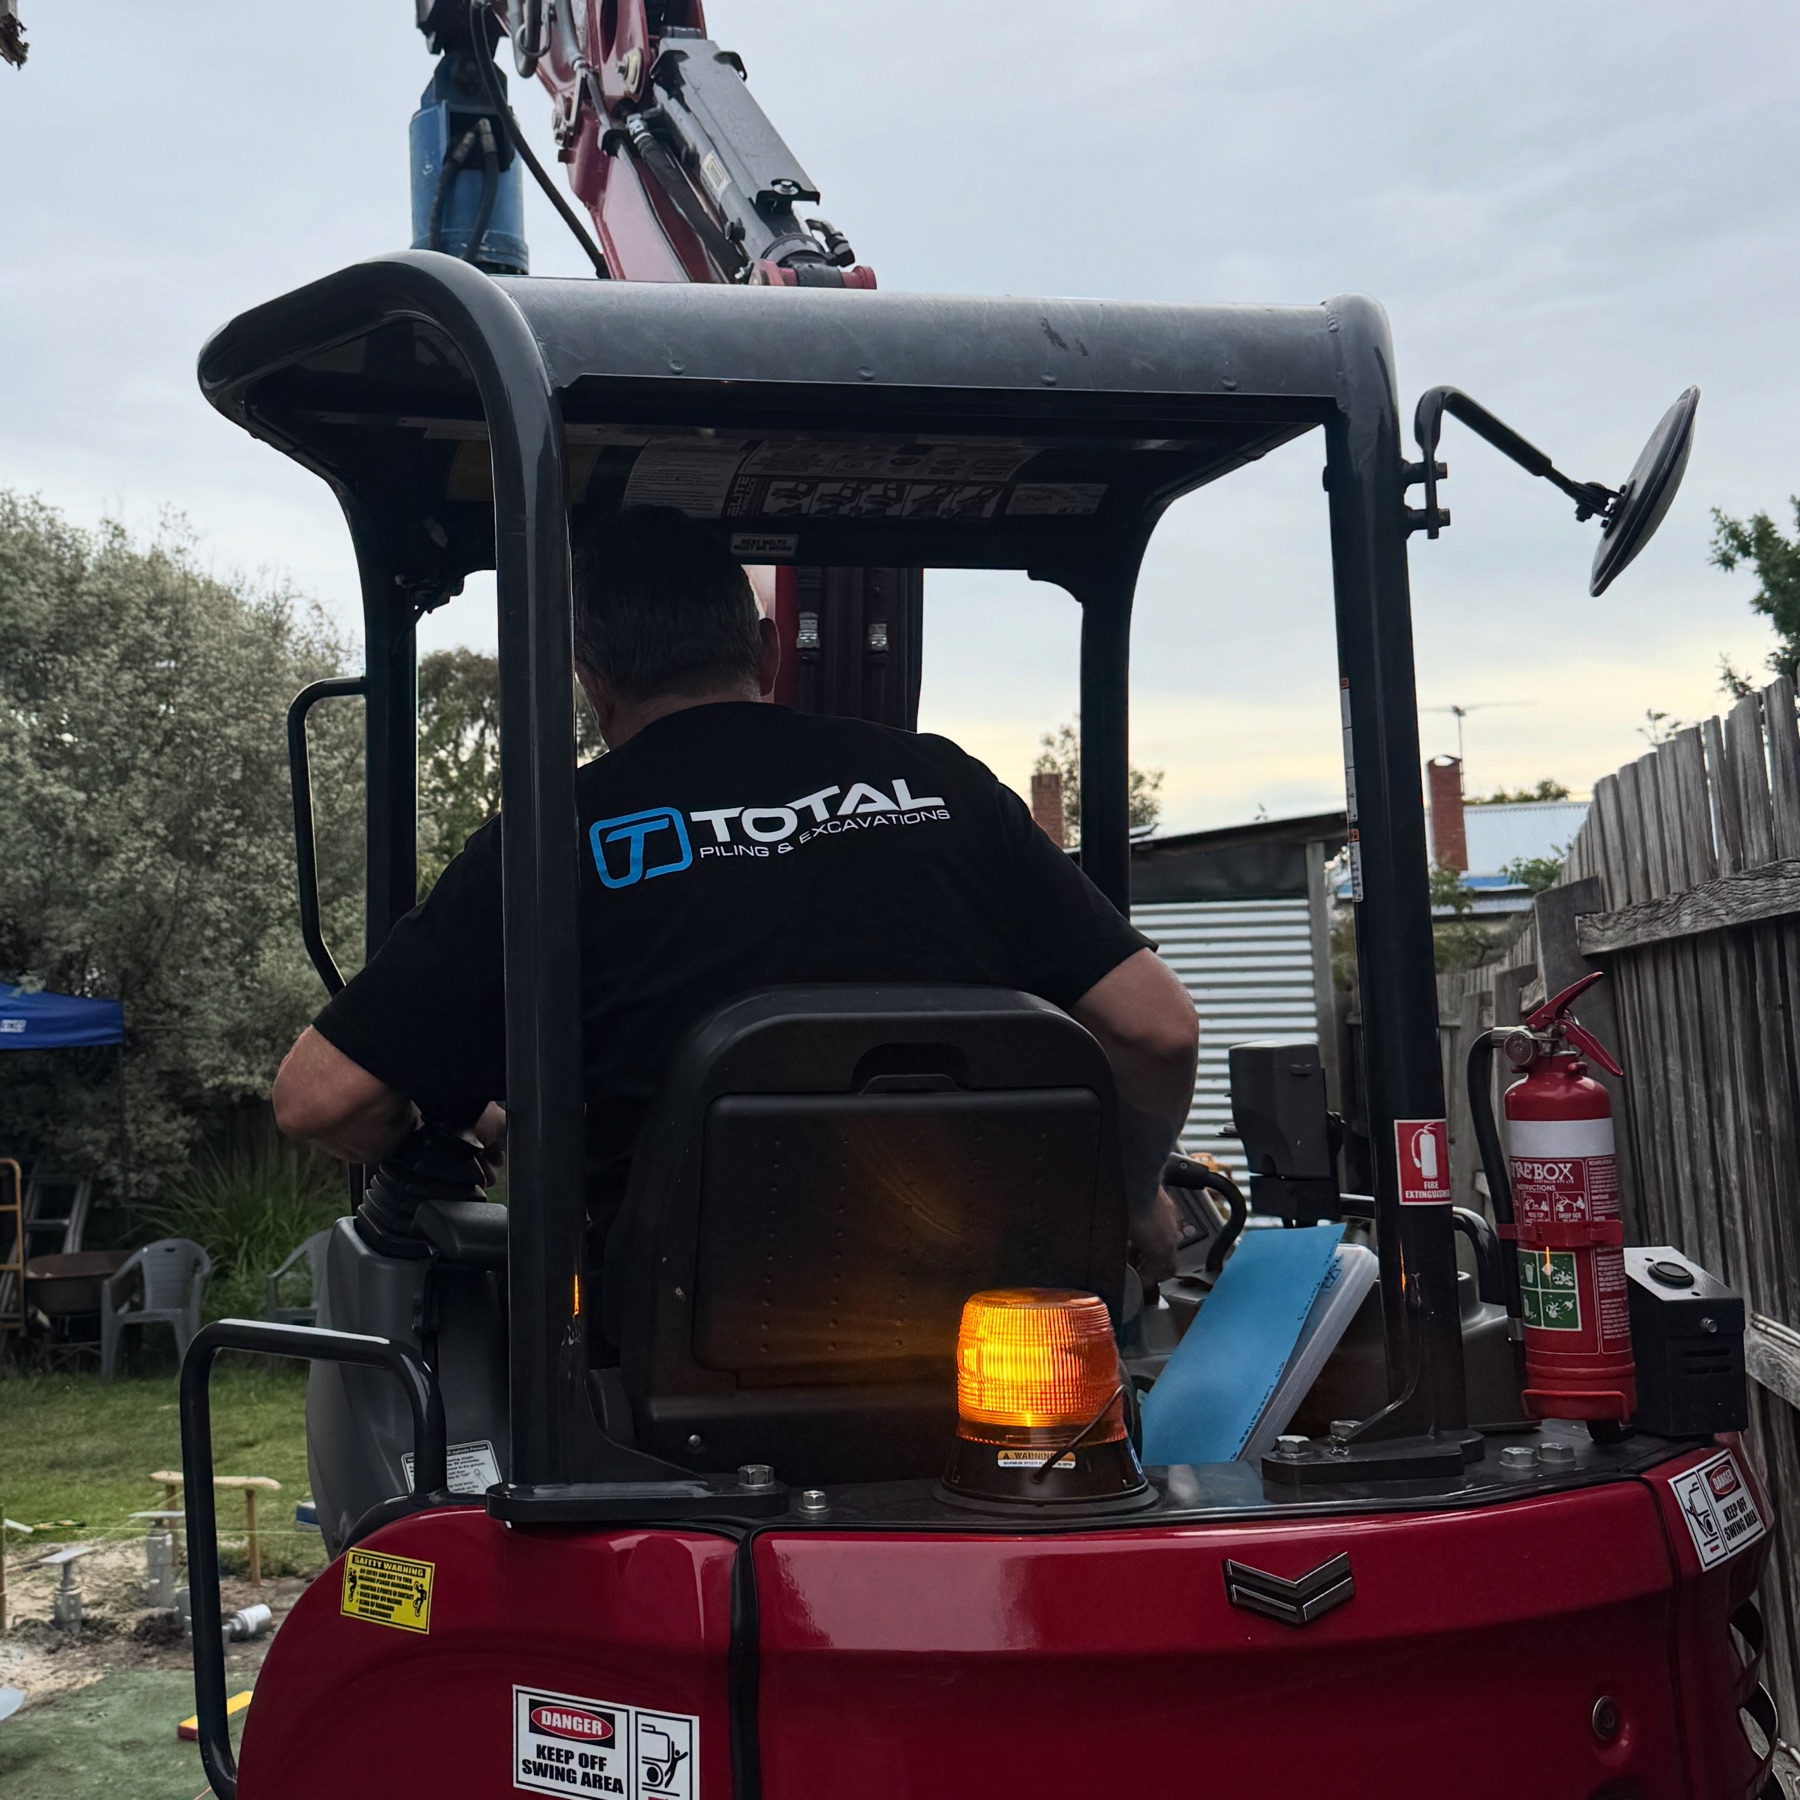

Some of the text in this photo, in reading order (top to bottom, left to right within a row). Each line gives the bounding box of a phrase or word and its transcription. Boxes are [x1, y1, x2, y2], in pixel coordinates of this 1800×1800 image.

[690, 778, 945, 843] TOTAL
[699, 809, 951, 859] PILING & EXCAVATIONS
[1510, 1161, 1574, 1180] IREBOX
[1424, 1181, 1439, 1190] FIRE
[1712, 1469, 1734, 1490] DANGER
[1723, 1496, 1748, 1522] KEEP OFF
[1723, 1509, 1758, 1541] SWING AREA
[354, 1556, 424, 1576] SAFETY WARNING
[541, 1710, 603, 1735] DANGER
[536, 1743, 607, 1772] KEEP OFF
[522, 1758, 624, 1794] SWING AREA
